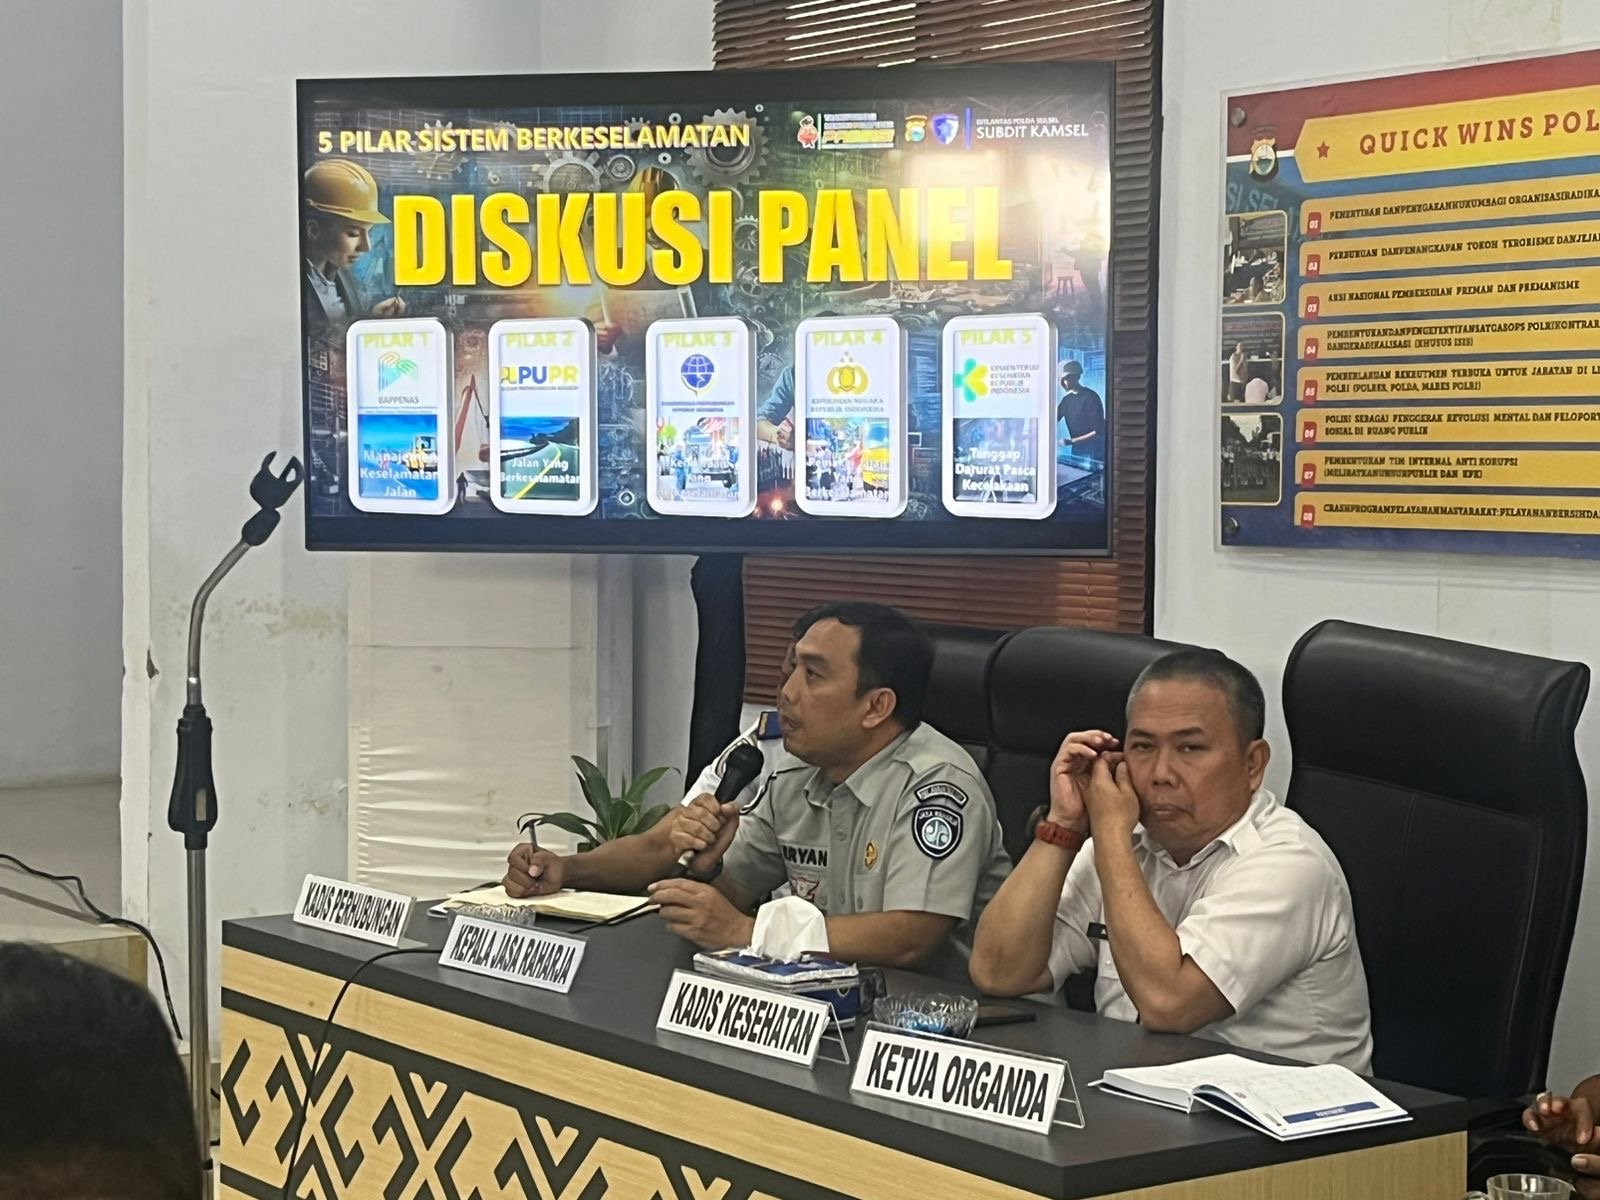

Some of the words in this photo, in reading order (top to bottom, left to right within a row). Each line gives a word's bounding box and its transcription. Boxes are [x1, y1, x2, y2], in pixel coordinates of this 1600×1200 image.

[318, 130, 333, 153] 5
[340, 129, 411, 152] PILAR
[417, 127, 509, 151] SISTEM
[517, 124, 750, 151] BERKESELAMATAN
[976, 125, 1027, 139] SUBDIT
[1031, 124, 1089, 137] KAMSEL
[1360, 126, 1448, 155] QUICK
[1458, 116, 1533, 144] WINS
[1543, 109, 1600, 136] POL
[393, 190, 733, 287] DISKUSI
[758, 185, 1014, 284] PANEL
[1466, 241, 1498, 251] TOKOH
[1502, 236, 1555, 249] TERORISME
[1328, 293, 1346, 302] AKSI
[1348, 290, 1391, 302] NASIONAL
[1392, 287, 1453, 299] PEMBERSIHAN
[1456, 284, 1494, 295] PREMAN
[1497, 283, 1516, 293] DAN
[1519, 280, 1580, 292] PREMANISME
[363, 332, 414, 348] PILAR
[420, 331, 429, 347] 1
[506, 331, 557, 347] PILAR
[562, 331, 573, 347] 2
[663, 331, 717, 348] PILAR
[722, 331, 733, 348] 3
[812, 330, 866, 347] PILAR
[871, 330, 883, 344] 4
[960, 329, 1014, 345] PILAR
[1021, 329, 1032, 344] 5
[1306, 346, 1316, 354] 04
[518, 366, 578, 384] PUPR
[1395, 370, 1447, 380] REKRUTMEN
[1451, 368, 1492, 378] TERBUKA
[1495, 367, 1527, 377] UNTUK
[1531, 367, 1572, 376] JABATAN
[1577, 366, 1587, 375] DI
[1325, 383, 1349, 392] POLRI
[1422, 382, 1450, 391] MABES
[378, 396, 419, 404] BAPPENAS
[1325, 415, 1352, 423] POLISI
[1355, 414, 1389, 423] SEBAGAI
[1392, 414, 1443, 423] PENGGERAK
[1446, 413, 1489, 423] REVOLUSI
[1493, 413, 1531, 422] MENTAL
[1532, 413, 1552, 421] DAN
[1325, 427, 1353, 435] SOSIAL
[1354, 426, 1364, 435] DI
[1367, 426, 1396, 435] RUANG
[1397, 426, 1429, 435] PUBLIK
[970, 448, 1020, 460] Tanggap
[1389, 456, 1405, 465] TIM
[1408, 457, 1452, 465] INTERNAL
[1479, 458, 1518, 466] KORUPSI
[512, 458, 539, 468] Jalan
[955, 464, 1000, 476] Darurat
[1004, 464, 1036, 476] Pasca
[1440, 469, 1458, 478] DAN
[384, 486, 416, 498] Jalan
[962, 480, 1029, 492] Kecelakaan
[301, 882, 335, 920] KADIS
[328, 889, 405, 938] PERHUBUNGAN
[450, 924, 498, 967] KEPALA
[489, 931, 527, 974] JASA
[518, 938, 576, 985] RAHARJA
[669, 981, 723, 1033] KADIS
[718, 993, 819, 1056] KESEHATAN
[866, 1041, 940, 1099] KETUA
[942, 1056, 1050, 1123] ORGANDA
